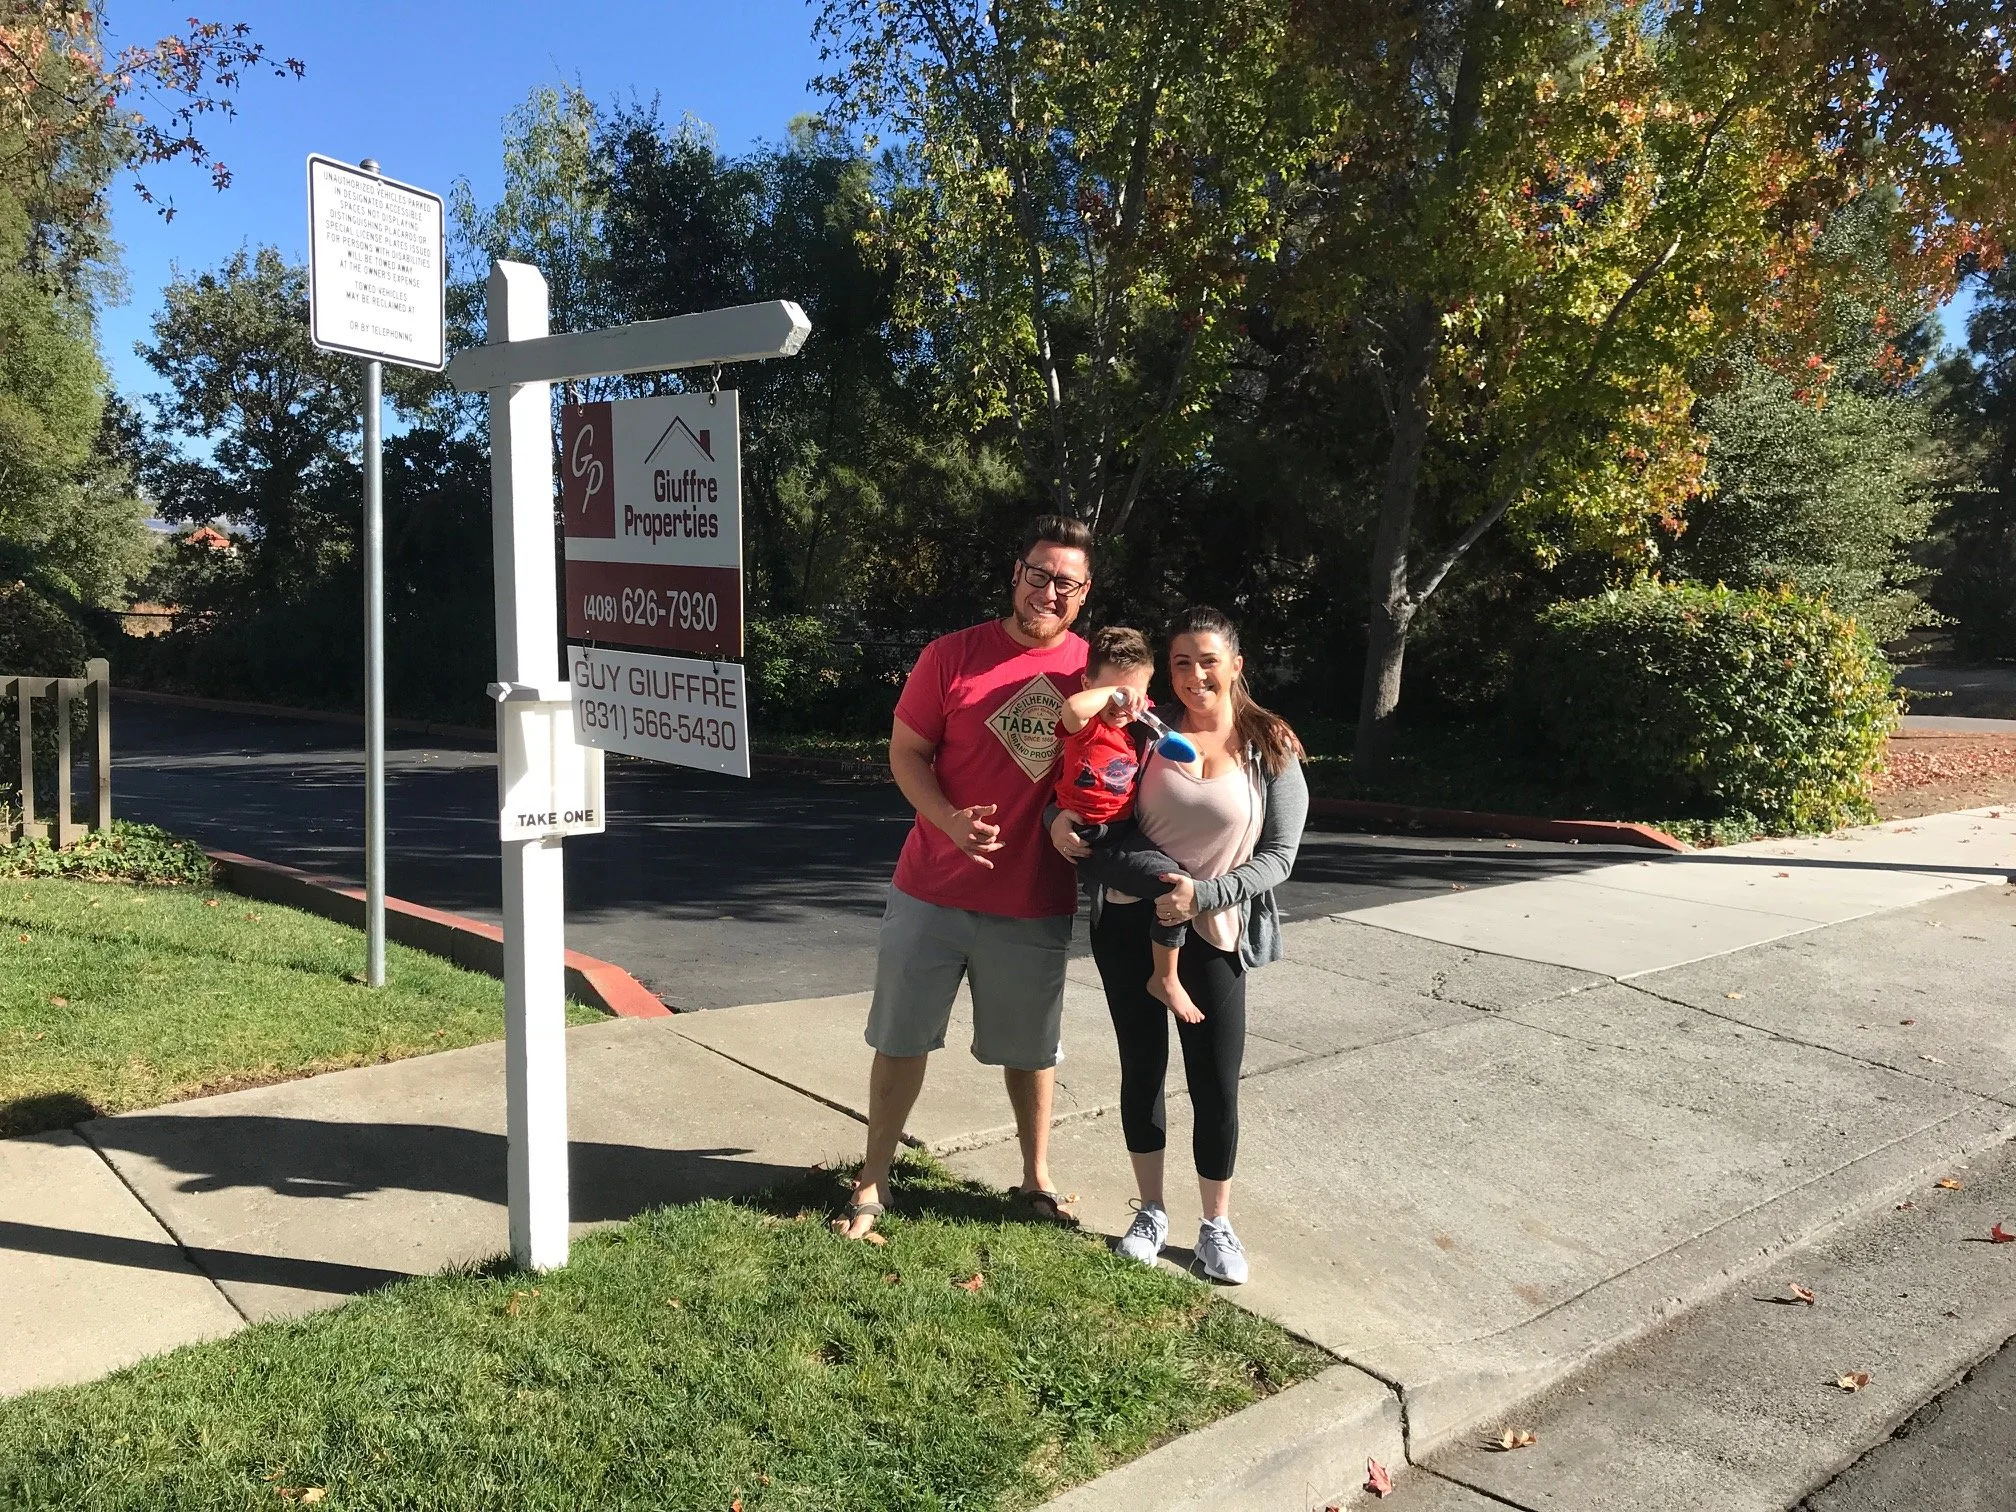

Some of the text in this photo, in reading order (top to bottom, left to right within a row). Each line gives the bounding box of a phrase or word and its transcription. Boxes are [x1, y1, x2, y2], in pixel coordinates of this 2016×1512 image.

[324, 171, 431, 212] UNAUTHORIZED VEHICLES PARKED
[334, 186, 422, 221] IN DESIGNATED ACCESSIBLE
[330, 209, 427, 244] DISTINGUISHING PLACARDS OR
[340, 200, 418, 231] SPACES NOT DISPLAYING
[326, 220, 431, 257] SPECIAL LICENSE PLATES ISSUED
[326, 232, 430, 268] FOR PERSONS WITH DISABILITIES
[340, 260, 347, 268] AT
[350, 261, 361, 273] THE
[393, 273, 420, 288] EXPENSE
[348, 250, 412, 274] WILL BE TOWED AWAY
[346, 291, 415, 314] MAY BE RECLAIMED AT
[355, 281, 408, 301] TOWED VEHICLES
[350, 321, 413, 342] OR BY TELEPHONING
[654, 469, 718, 503] Giuffre
[624, 504, 719, 545] Properties
[583, 587, 718, 632] (408) 626-7930
[575, 660, 737, 709] GUY GIUFFRE
[579, 699, 736, 751] (831) 566-5430
[1010, 733, 1029, 756] BRAND
[518, 810, 594, 826] TAKE ONE
